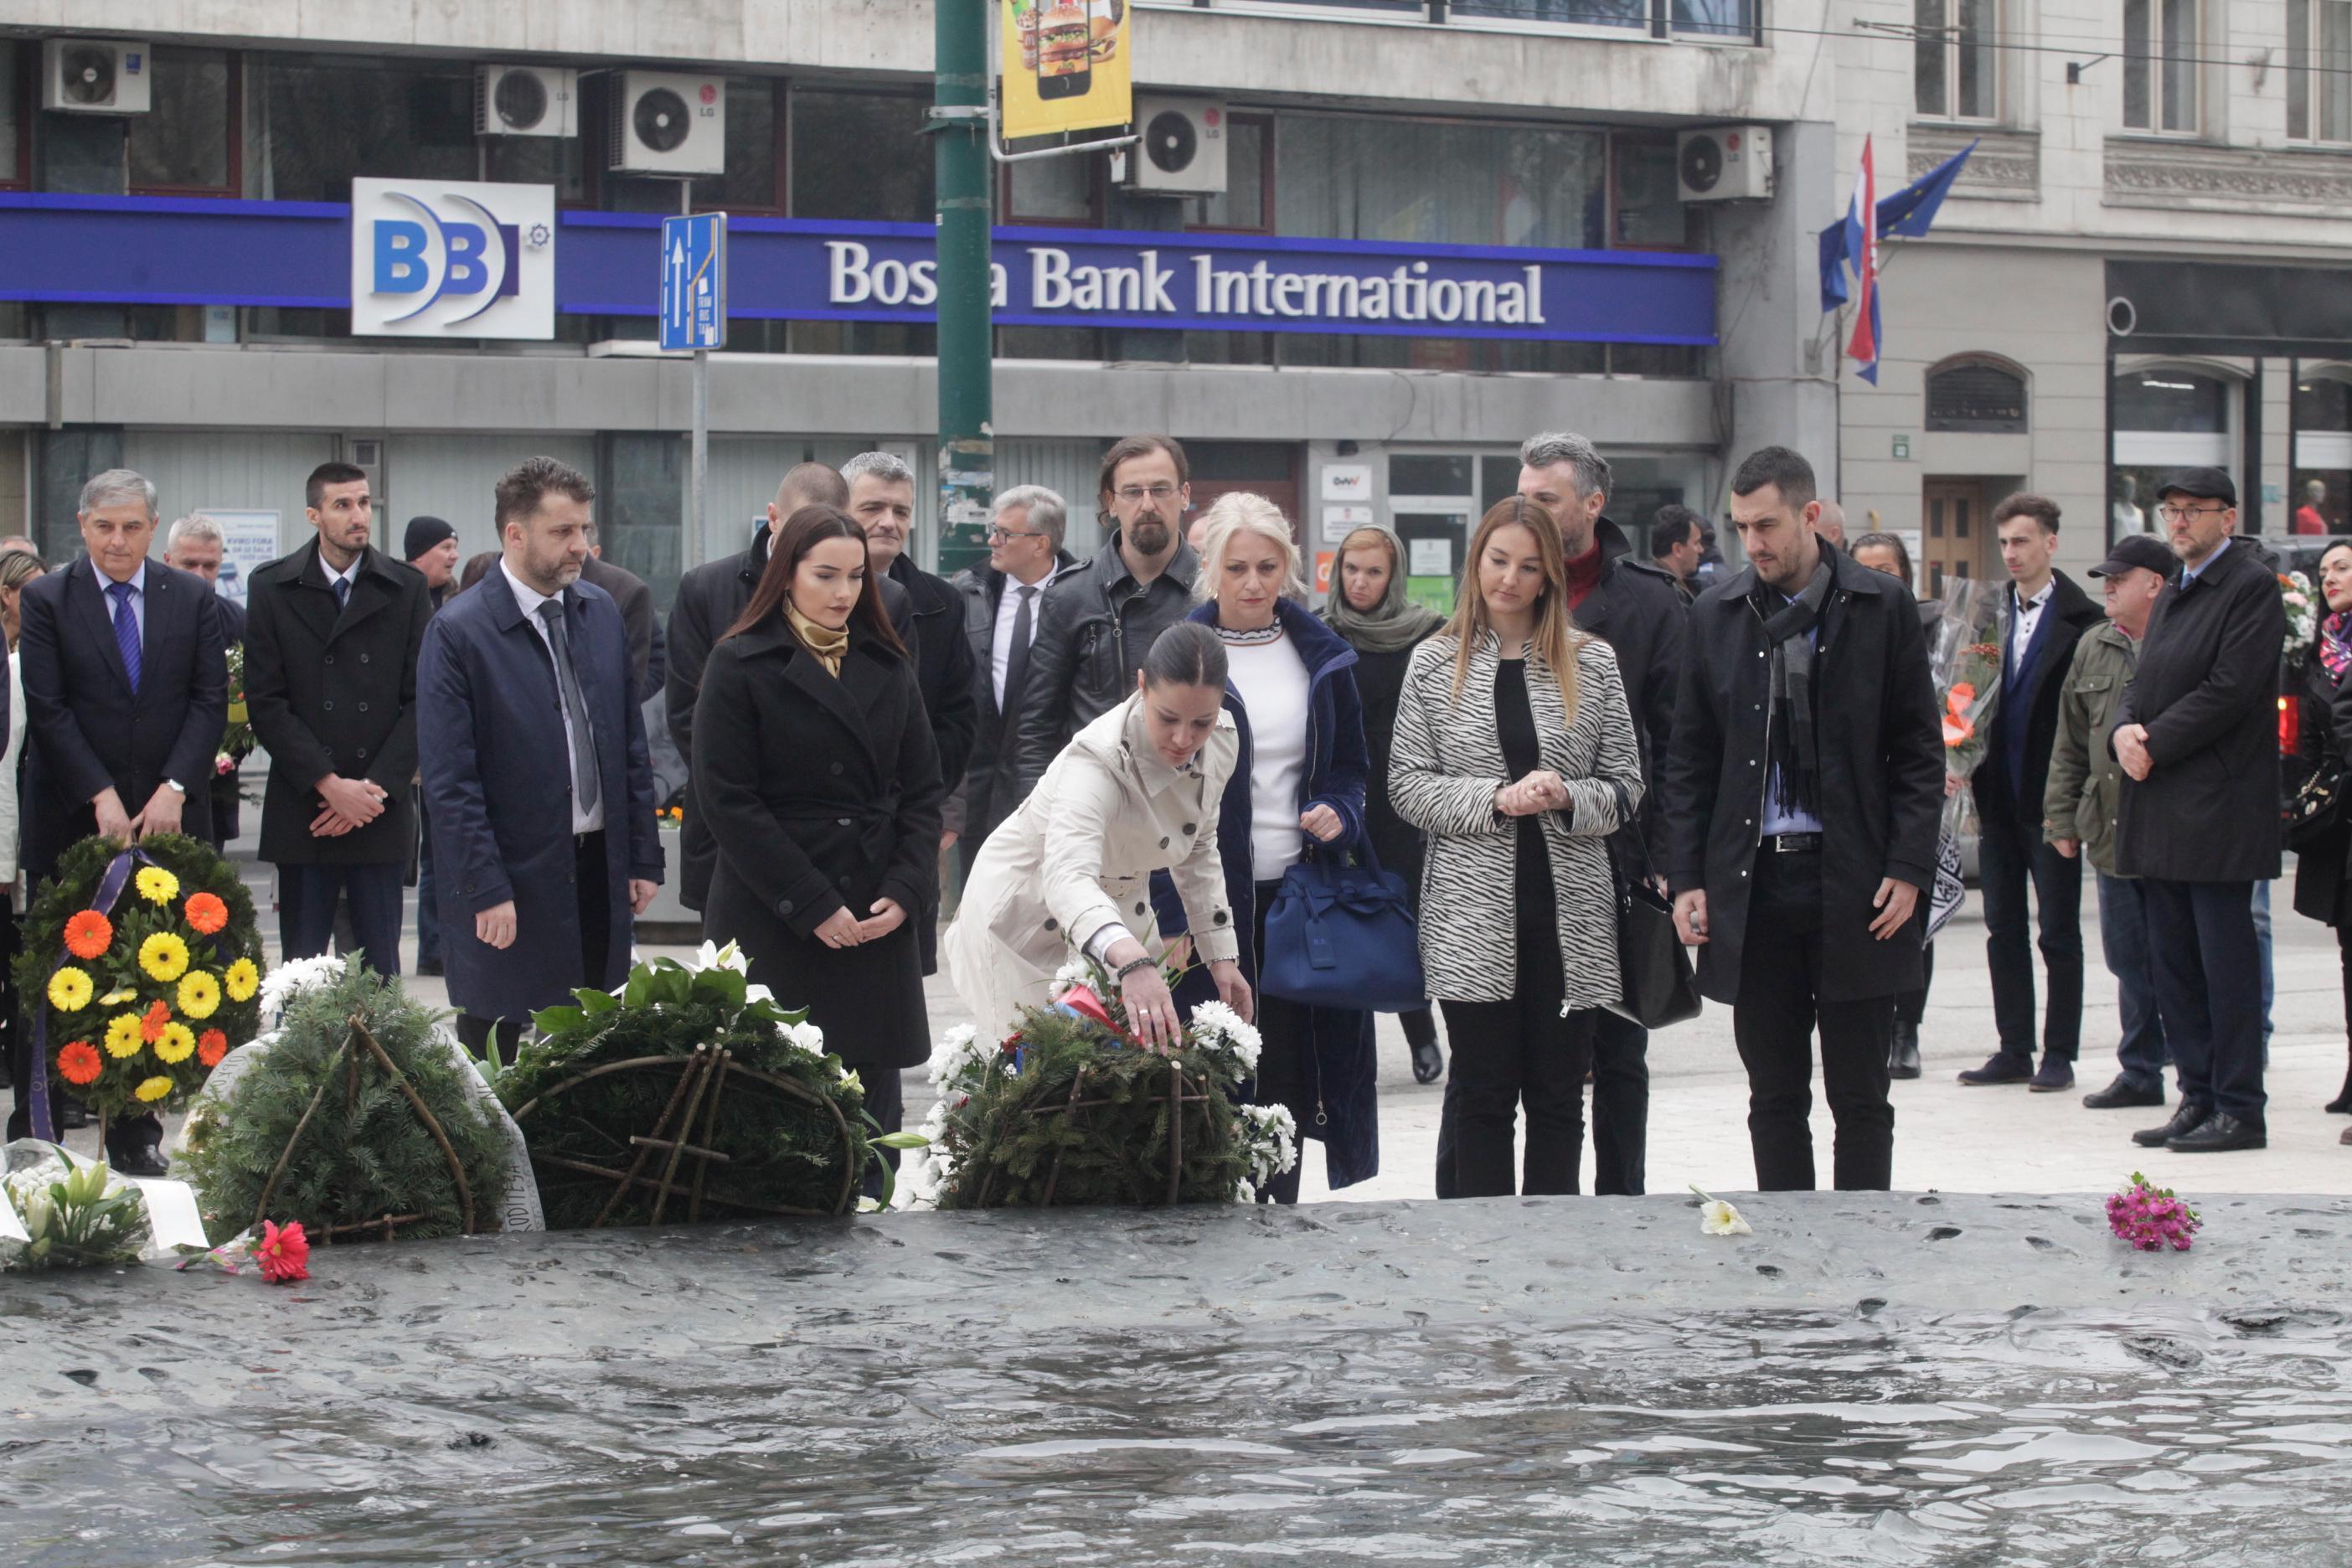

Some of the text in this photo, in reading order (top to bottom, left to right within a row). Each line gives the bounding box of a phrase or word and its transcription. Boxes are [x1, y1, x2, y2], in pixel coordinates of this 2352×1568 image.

[699, 107, 714, 116] LG
[1206, 129, 1220, 139] LG
[374, 216, 520, 298] BBI
[824, 241, 1546, 324] Bosa Bank International
[699, 309, 709, 322] BUS
